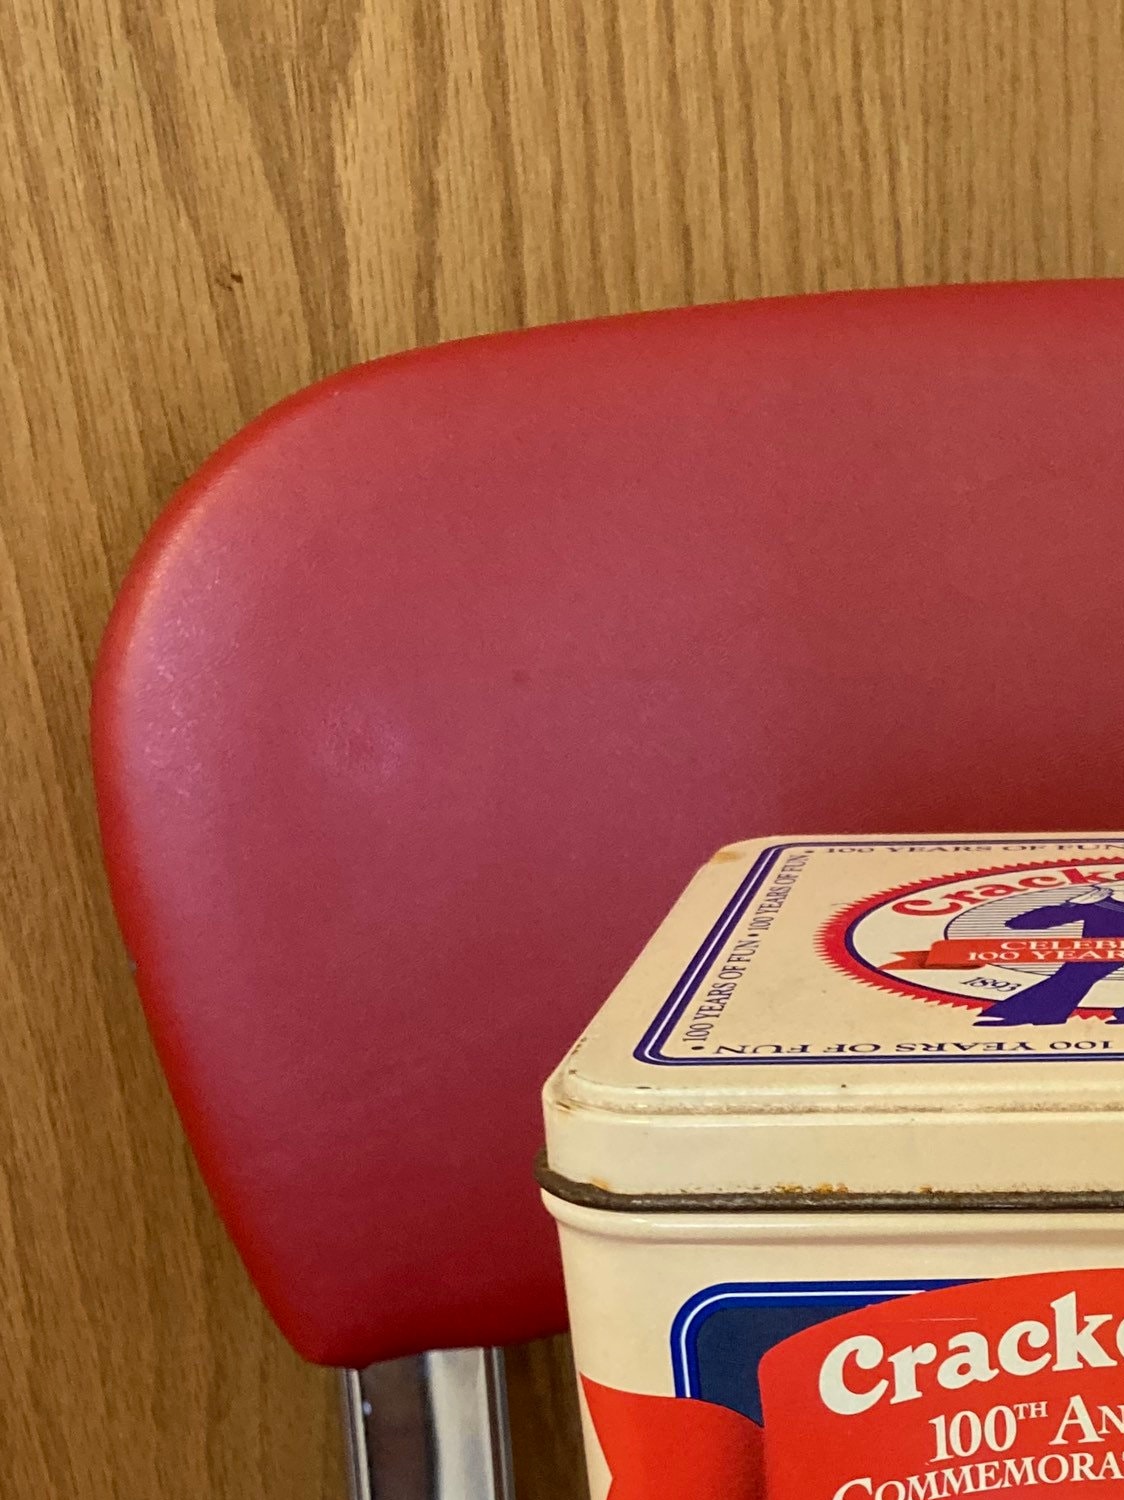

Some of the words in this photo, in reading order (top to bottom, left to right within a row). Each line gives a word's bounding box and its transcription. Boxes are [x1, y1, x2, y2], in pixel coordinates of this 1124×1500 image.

[781, 854, 809, 872] FUN
[774, 873, 799, 885] OF
[756, 886, 790, 913] YEARS
[748, 916, 774, 931] 100
[727, 940, 761, 963] FUN
[967, 951, 1019, 961] 100
[718, 966, 746, 980] OF
[960, 976, 1022, 991] 1893
[693, 982, 737, 1019] YEARS
[683, 1023, 714, 1042] 100
[715, 1044, 810, 1054] FUN
[825, 1043, 881, 1053] OF
[895, 1041, 1037, 1052] YEARS
[1049, 1040, 1112, 1050] 100
